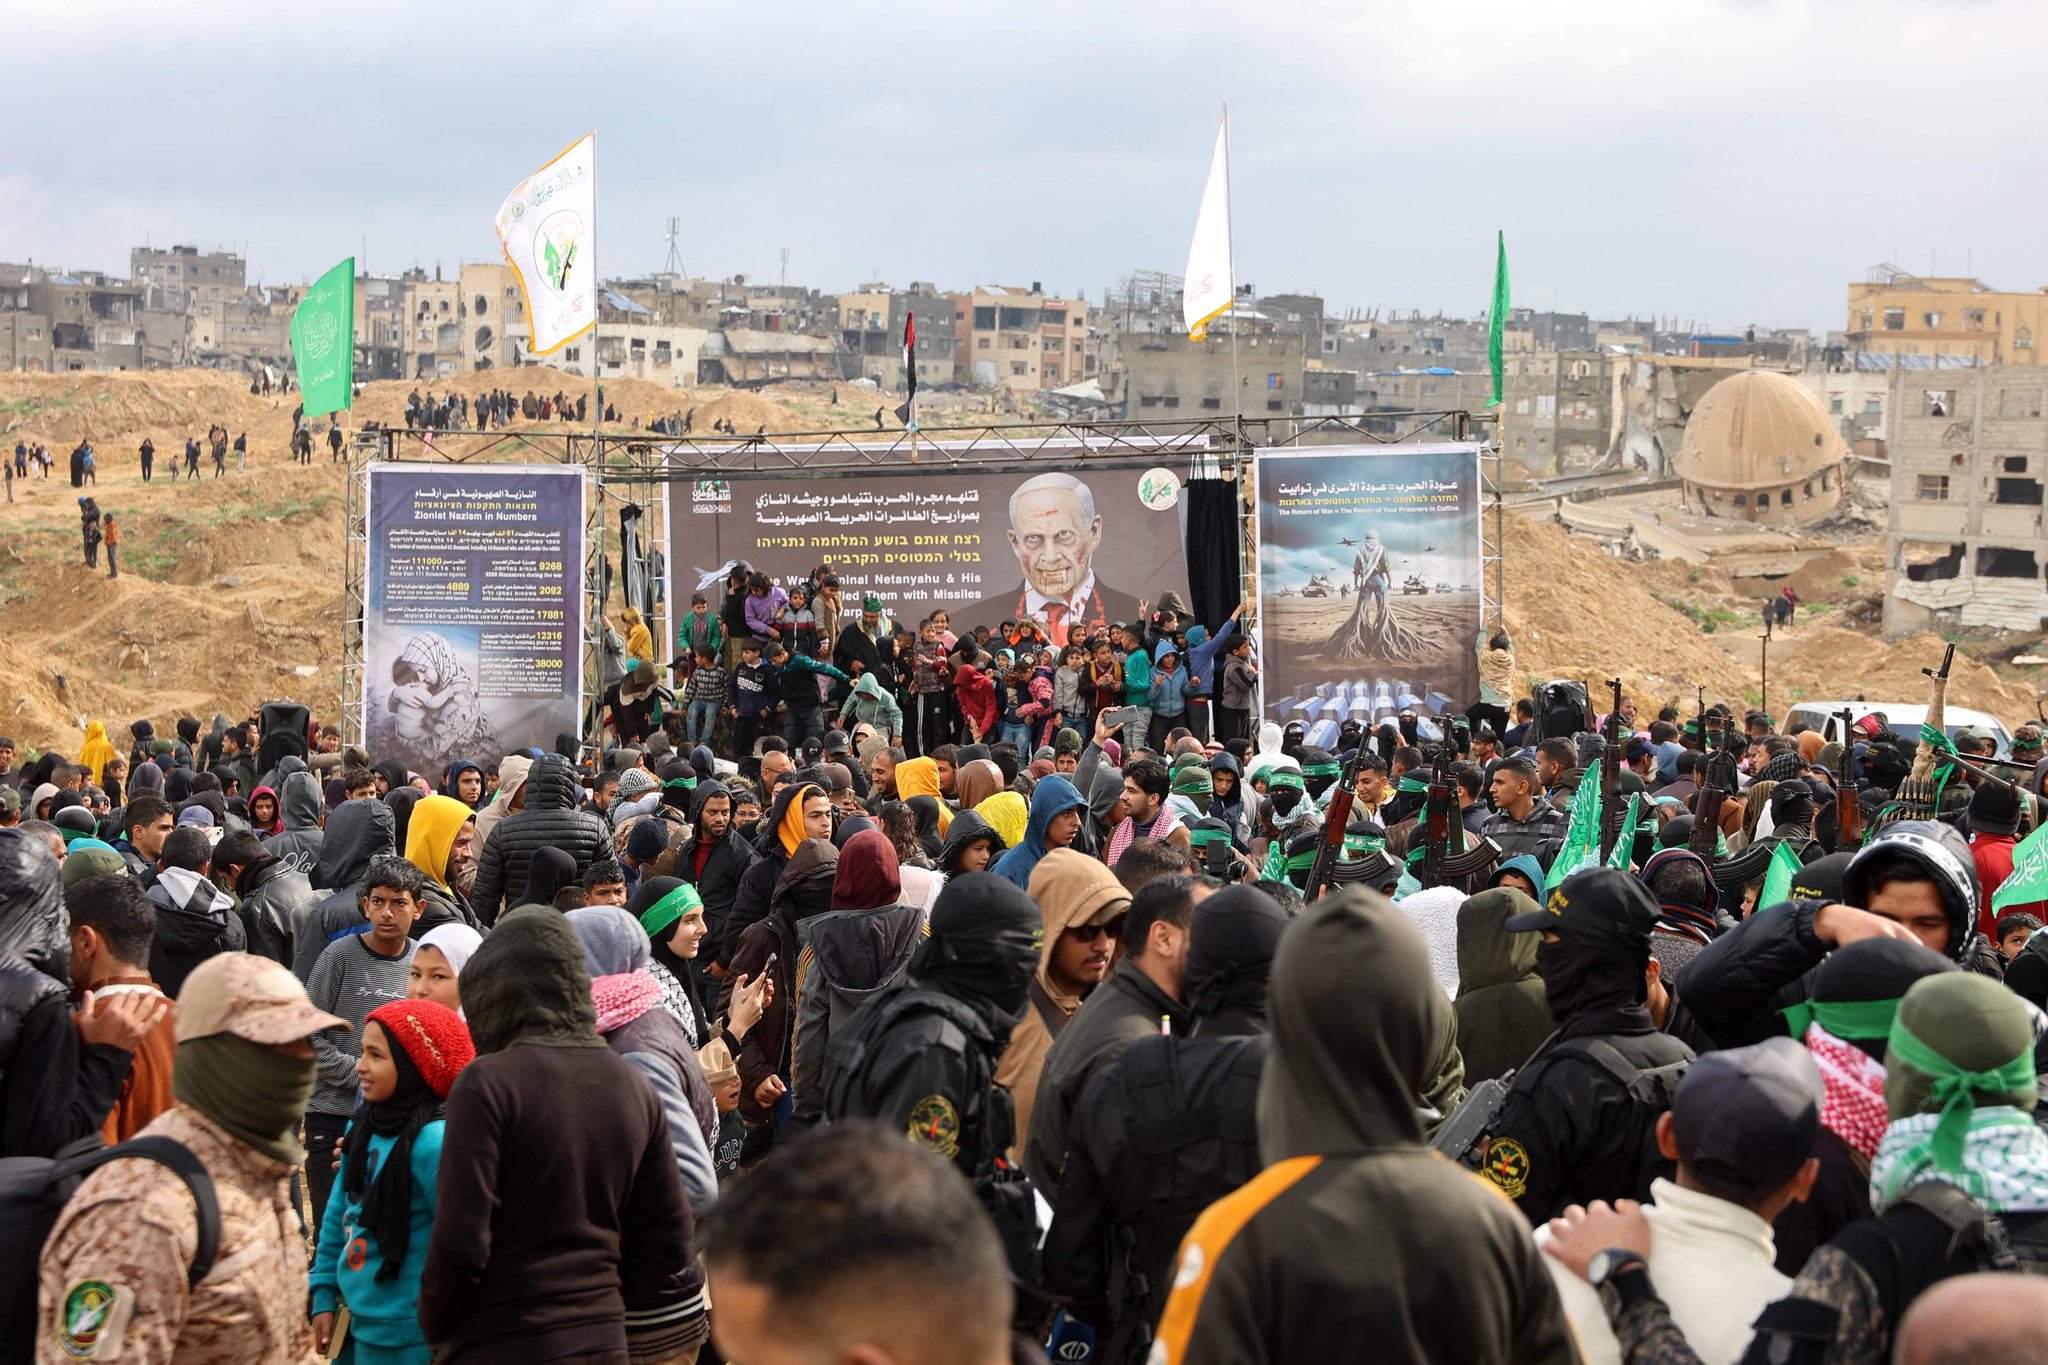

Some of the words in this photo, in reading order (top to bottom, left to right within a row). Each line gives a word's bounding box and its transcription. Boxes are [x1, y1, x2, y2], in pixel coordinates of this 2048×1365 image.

[1279, 482, 1311, 495] توابيت
[1312, 482, 1327, 496] في
[1328, 480, 1359, 494] الأسرى
[1361, 481, 1387, 493] عودة
[1395, 481, 1427, 493] الحرب
[1429, 480, 1458, 492] عودة
[415, 487, 441, 498] أرقام
[442, 489, 460, 500] في
[829, 492, 873, 503] نتنياهو
[946, 490, 979, 505] قتلهم
[756, 493, 791, 509] النازي
[792, 491, 829, 507] وجيشه
[874, 492, 914, 506] الحرب
[915, 493, 944, 506] مجرم
[1279, 498, 1312, 506] בארונות
[1394, 495, 1428, 503] למלחמה
[466, 501, 501, 511] התקפות
[505, 502, 537, 510] תוצאות
[414, 511, 446, 520] Zionist
[449, 511, 482, 521] Nazism
[485, 512, 493, 520] in
[496, 512, 537, 521] Numbers
[756, 511, 822, 526] الصهيونية
[824, 511, 873, 525] الحربية
[874, 510, 929, 524] الطائرات
[931, 509, 980, 524] بصواريخ
[757, 537, 805, 548] נתנייהו
[811, 534, 868, 545] המלחמה
[874, 535, 908, 546] בושע
[914, 535, 948, 545] אותם
[954, 534, 980, 544] רצח
[412, 557, 442, 565] 111000
[823, 553, 878, 566] הקרביים
[885, 553, 943, 563] המטוסים
[949, 550, 981, 562] בטלי
[539, 562, 562, 570] 9268
[839, 574, 868, 585] minal
[875, 574, 940, 586] Netanyahu
[946, 573, 955, 583] &
[962, 573, 981, 583] His
[446, 582, 470, 591] 4889
[540, 586, 562, 595] 2092
[866, 590, 897, 600] Them
[903, 589, 928, 599] with
[934, 589, 981, 599] Missiles
[537, 610, 564, 619] 17881
[537, 631, 562, 640] 12316
[535, 659, 563, 668] 38000
